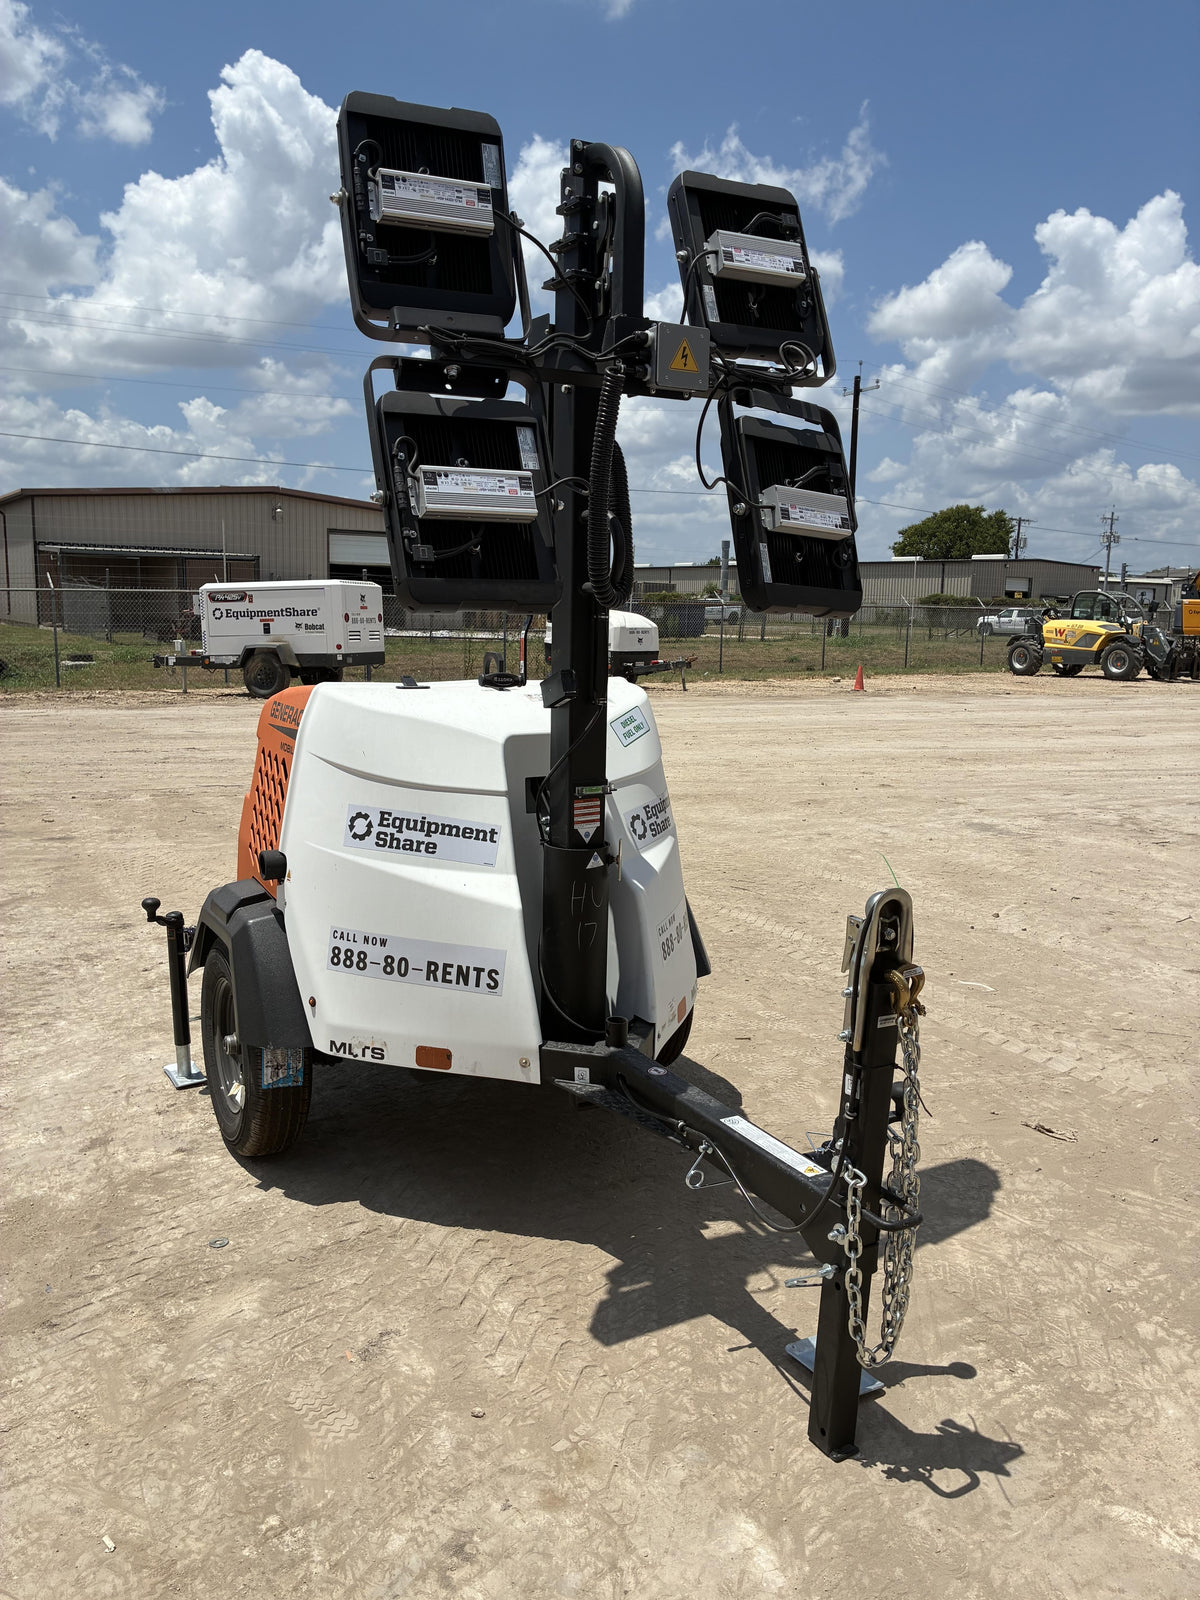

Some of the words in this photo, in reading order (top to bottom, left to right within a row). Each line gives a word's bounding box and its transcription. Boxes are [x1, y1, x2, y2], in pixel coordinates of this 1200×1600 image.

[225, 607, 318, 620] EquipmentShare
[304, 623, 325, 631] Bobcat
[620, 715, 637, 729] DIESEL
[622, 729, 635, 740] FUEL
[633, 722, 645, 733] ONLY
[377, 810, 498, 844] Equipment
[374, 830, 438, 855] Share
[332, 929, 358, 943] CALL
[363, 935, 388, 948] NOW
[330, 945, 500, 990] 888-80-RENTS
